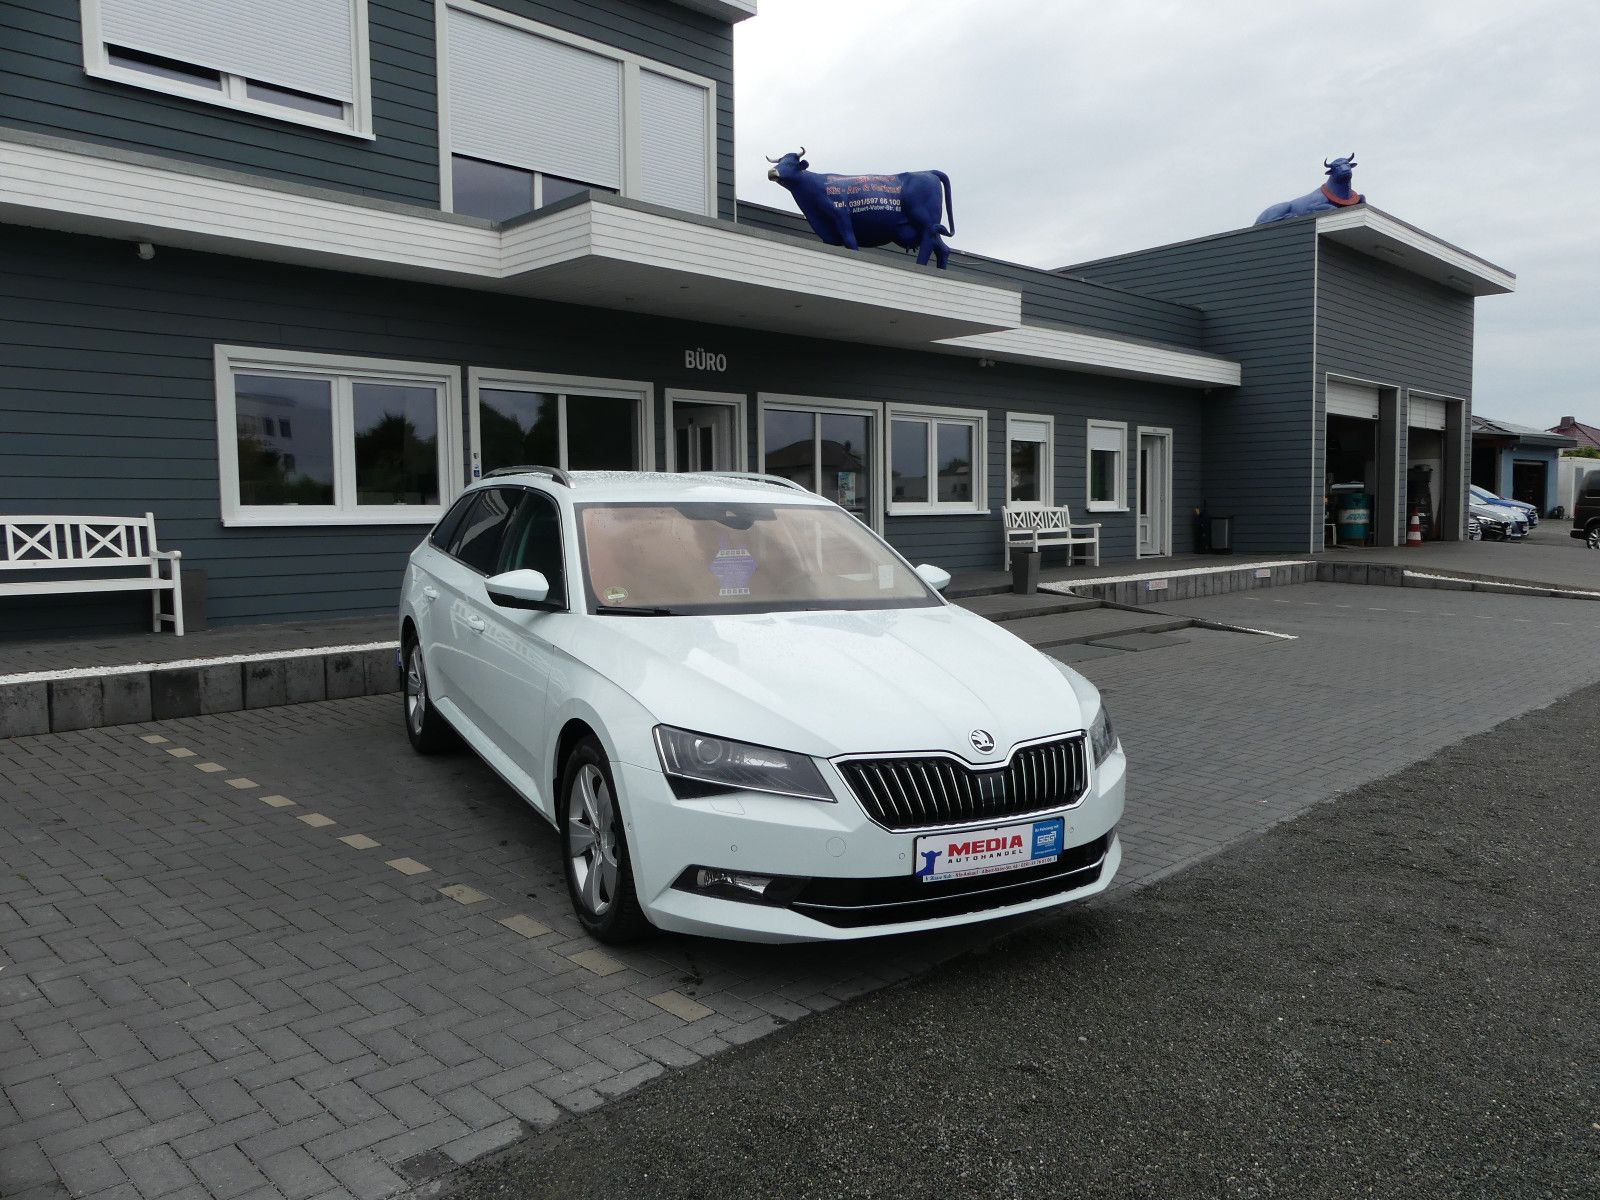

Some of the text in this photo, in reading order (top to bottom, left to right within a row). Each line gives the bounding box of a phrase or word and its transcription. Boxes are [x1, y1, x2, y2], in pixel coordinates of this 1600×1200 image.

[684, 347, 727, 372] BÜRO
[947, 834, 1024, 857] MEDIA
[947, 849, 1024, 864] AUTOHANDEL
